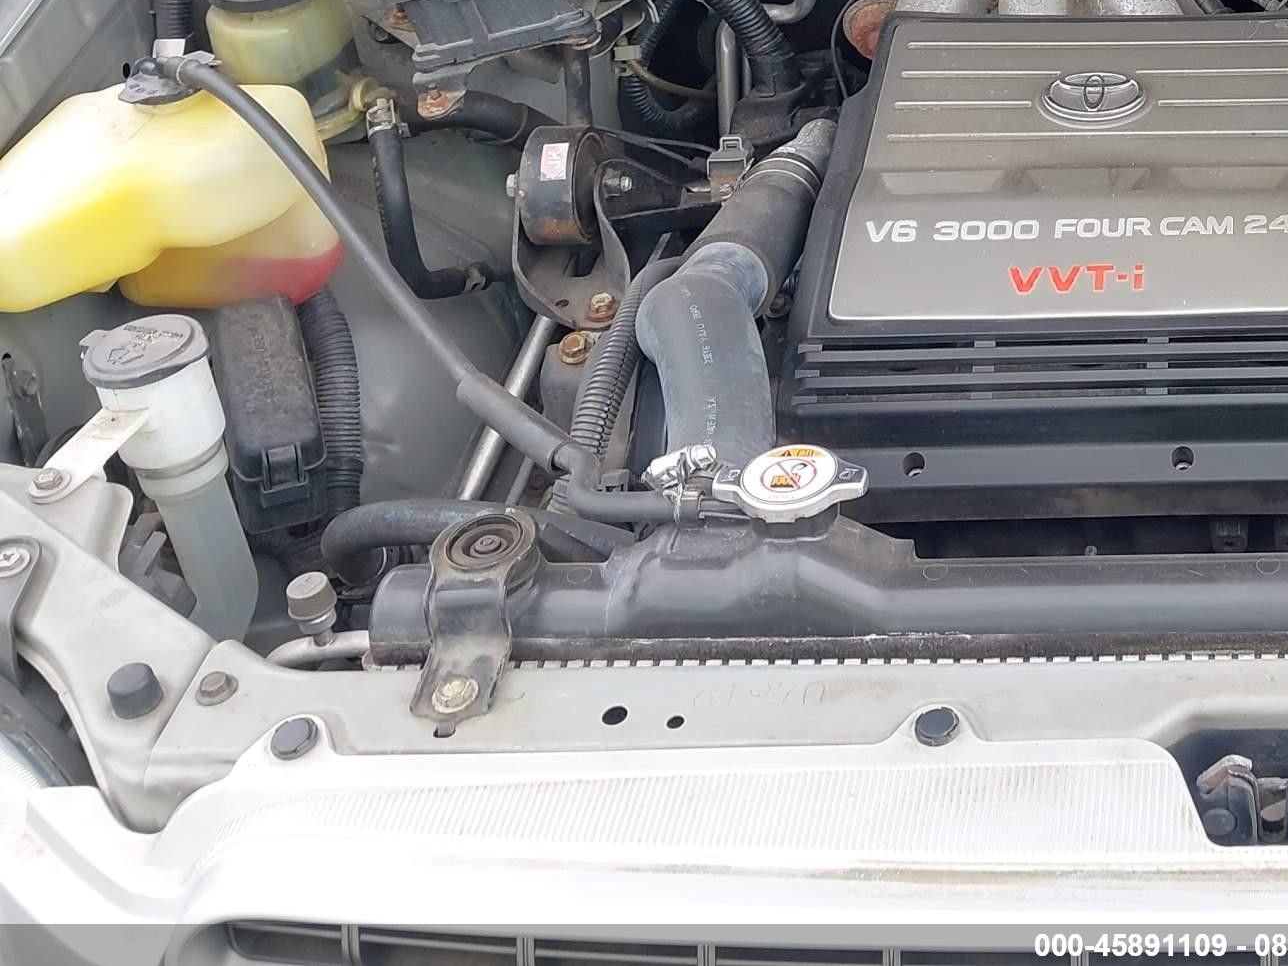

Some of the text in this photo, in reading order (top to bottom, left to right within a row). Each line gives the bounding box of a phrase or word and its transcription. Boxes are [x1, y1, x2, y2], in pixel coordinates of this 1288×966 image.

[865, 220, 918, 243] V6
[933, 219, 1040, 242] 3000
[1053, 216, 1152, 239] FOUR
[1160, 215, 1234, 236] CAM
[1007, 262, 1145, 295] VVT-i
